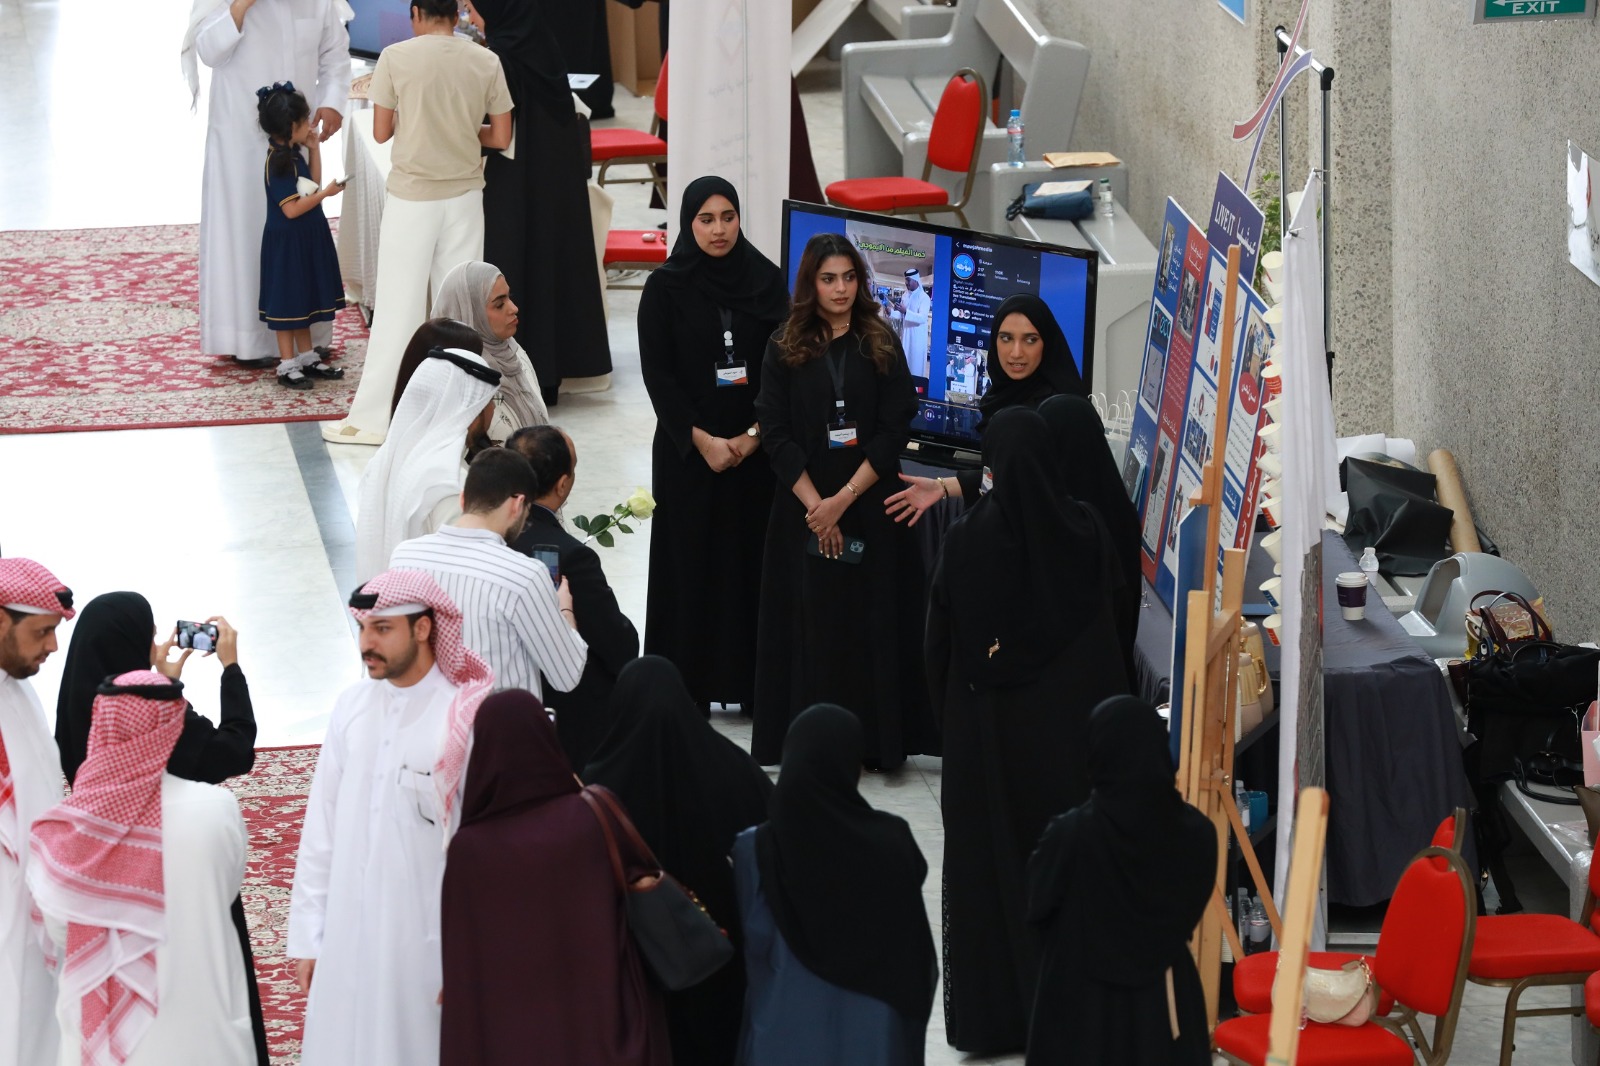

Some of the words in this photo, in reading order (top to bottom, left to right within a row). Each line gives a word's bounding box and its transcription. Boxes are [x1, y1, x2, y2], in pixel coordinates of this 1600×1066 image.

[1512, 1, 1560, 14] EXIT
[885, 244, 894, 253] من
[894, 247, 913, 257] الفيلم
[913, 249, 926, 258] خمن
